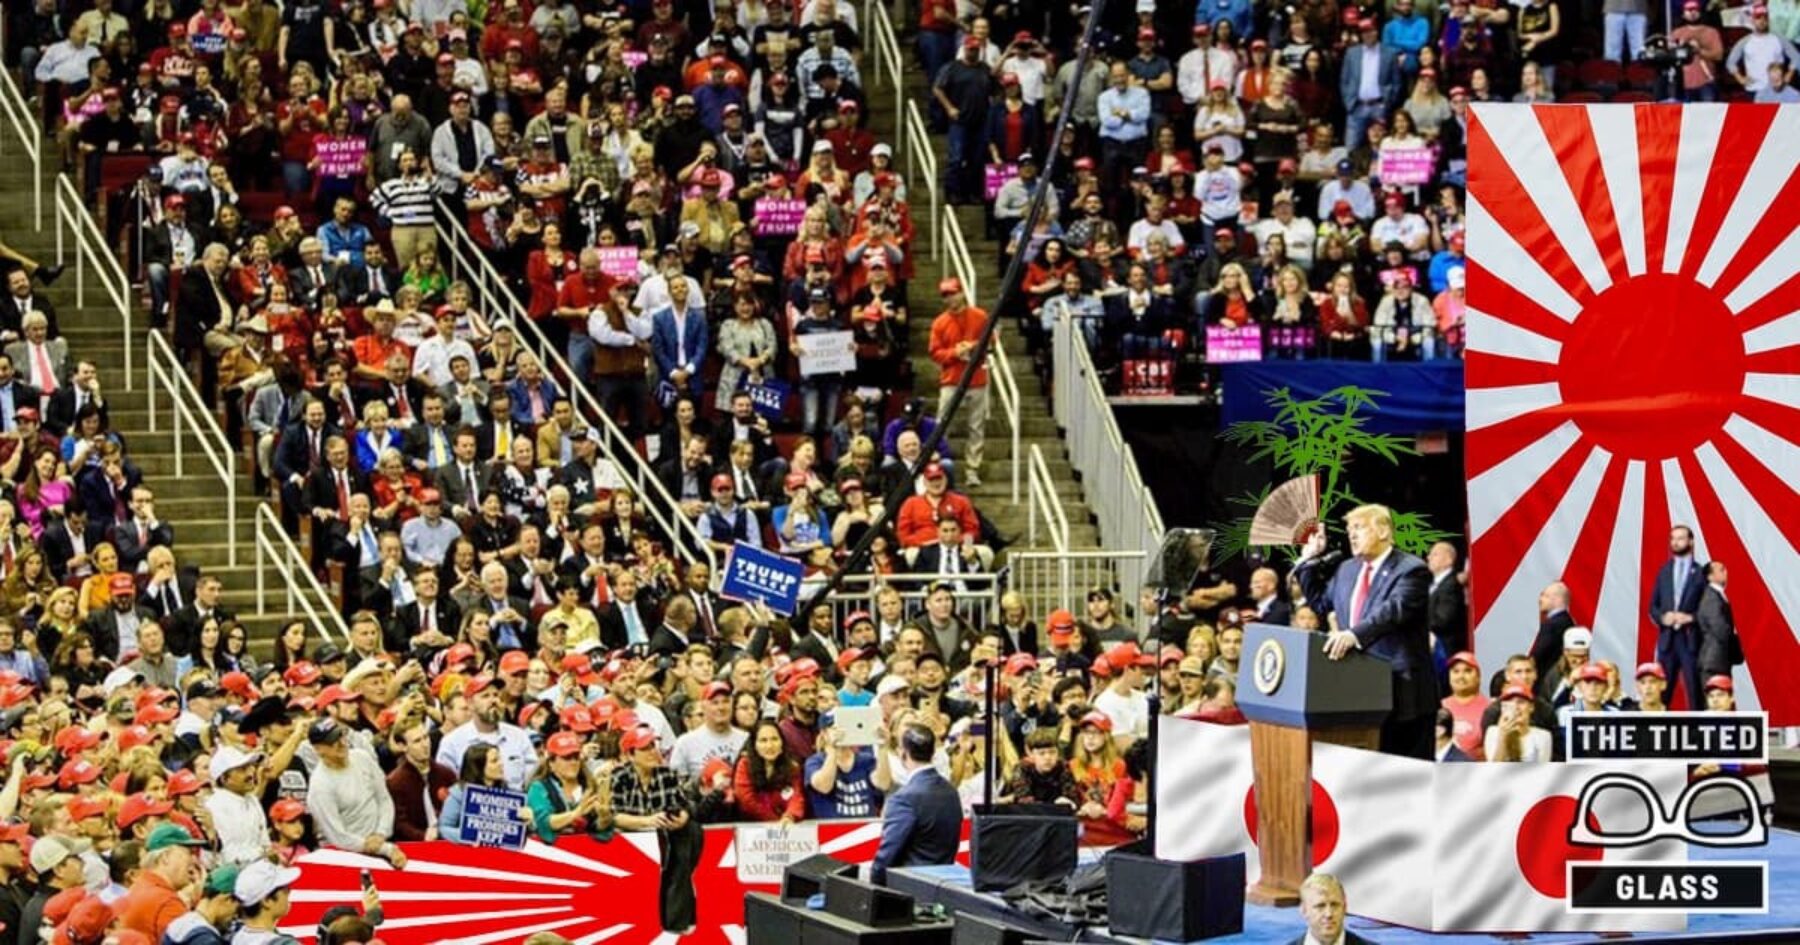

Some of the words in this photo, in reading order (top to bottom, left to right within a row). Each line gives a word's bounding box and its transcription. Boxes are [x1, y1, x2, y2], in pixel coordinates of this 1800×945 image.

[316, 140, 366, 152] WOMEN
[332, 153, 351, 161] FOR
[758, 223, 801, 234] TRUM
[598, 248, 638, 259] OMEN
[735, 557, 798, 586] TRUMP
[470, 791, 522, 811] PROMISES
[480, 804, 510, 823] MADE
[467, 816, 519, 836] PROMISES
[478, 830, 505, 845] KEPT
[767, 829, 789, 839] BUY
